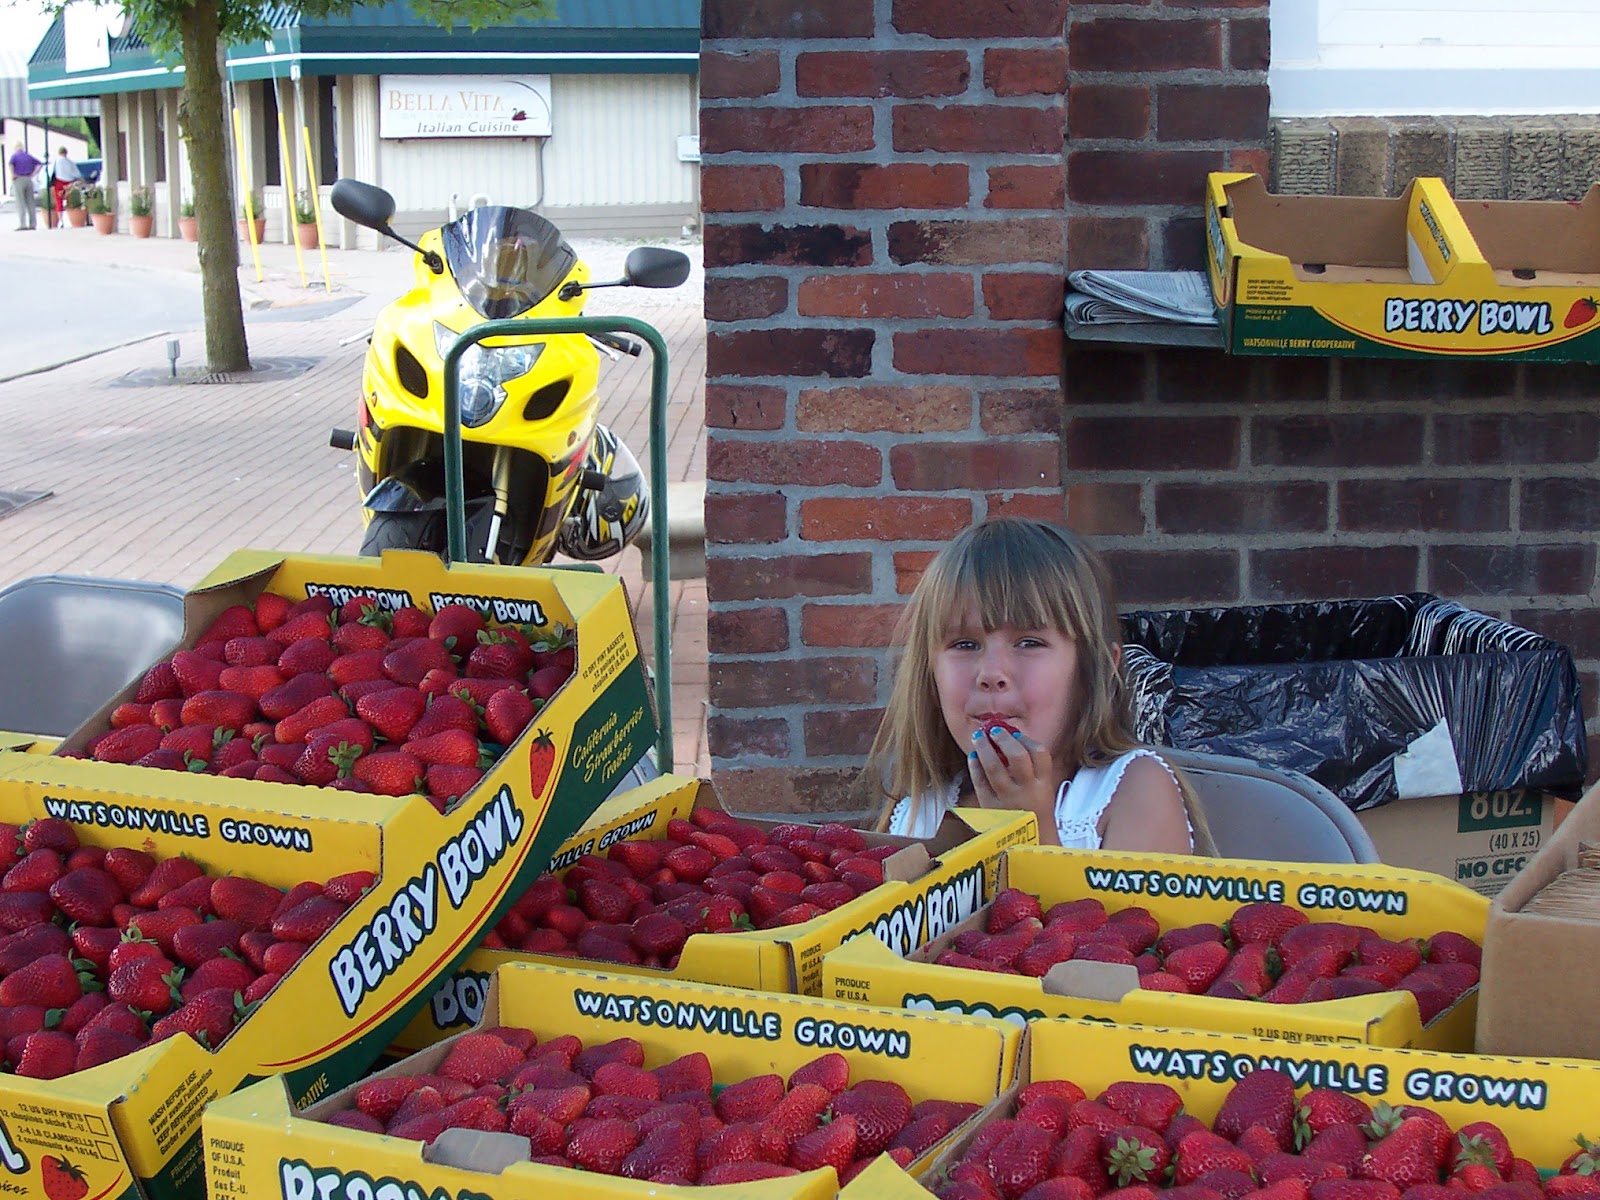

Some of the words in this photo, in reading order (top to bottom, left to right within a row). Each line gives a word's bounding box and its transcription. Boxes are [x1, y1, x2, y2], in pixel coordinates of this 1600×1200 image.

[388, 90, 452, 111] BELLA
[459, 91, 505, 111] VITA
[417, 122, 461, 133] Italian
[468, 121, 520, 133] Cuisine
[1384, 298, 1478, 334] BERRY
[1478, 301, 1554, 337] BOWL
[1244, 338, 1288, 348] WATSONVILLE
[1290, 339, 1311, 348] BERRY
[1312, 340, 1356, 349] COOPERATIVE
[490, 596, 548, 627] BOWL
[572, 711, 619, 769] California
[583, 706, 644, 783] Strawberries
[601, 742, 633, 784] Fraises
[44, 797, 208, 837] WATSONVILLE
[220, 820, 313, 852] GROWN
[599, 809, 657, 850] GROWN
[1489, 834, 1508, 852] (40
[1511, 833, 1519, 848] X
[1522, 830, 1540, 848] 25)
[1458, 861, 1488, 879] NO
[328, 863, 438, 1018] BERRY
[437, 782, 524, 910] BOWL
[1086, 866, 1284, 902] WATSONVILLE
[1298, 884, 1407, 915] GROWN
[835, 977, 871, 990] PRODUCE
[431, 969, 491, 1030] BO
[835, 989, 846, 998] OF
[847, 990, 870, 1002] U.S.A.
[574, 989, 781, 1037] WATSONVILLE
[794, 1018, 911, 1058] GROWN
[1252, 1027, 1264, 1037] 12
[1266, 1029, 1279, 1039] US
[1282, 1031, 1302, 1041] DRY
[1305, 1033, 1335, 1043] PINTS
[148, 1103, 166, 1126] WASH
[165, 1081, 187, 1108] BEFORE
[185, 1070, 198, 1085] USE
[1405, 1071, 1547, 1110] GROWN
[0, 1109, 9, 1117] 12
[18, 1103, 28, 1112] 12
[41, 1107, 58, 1117] DRY
[59, 1110, 84, 1122] PINTS
[156, 1126, 170, 1146] KEEP
[211, 1138, 245, 1153] PRODUCE
[212, 1152, 221, 1161] OF
[213, 1165, 240, 1179] Produit
